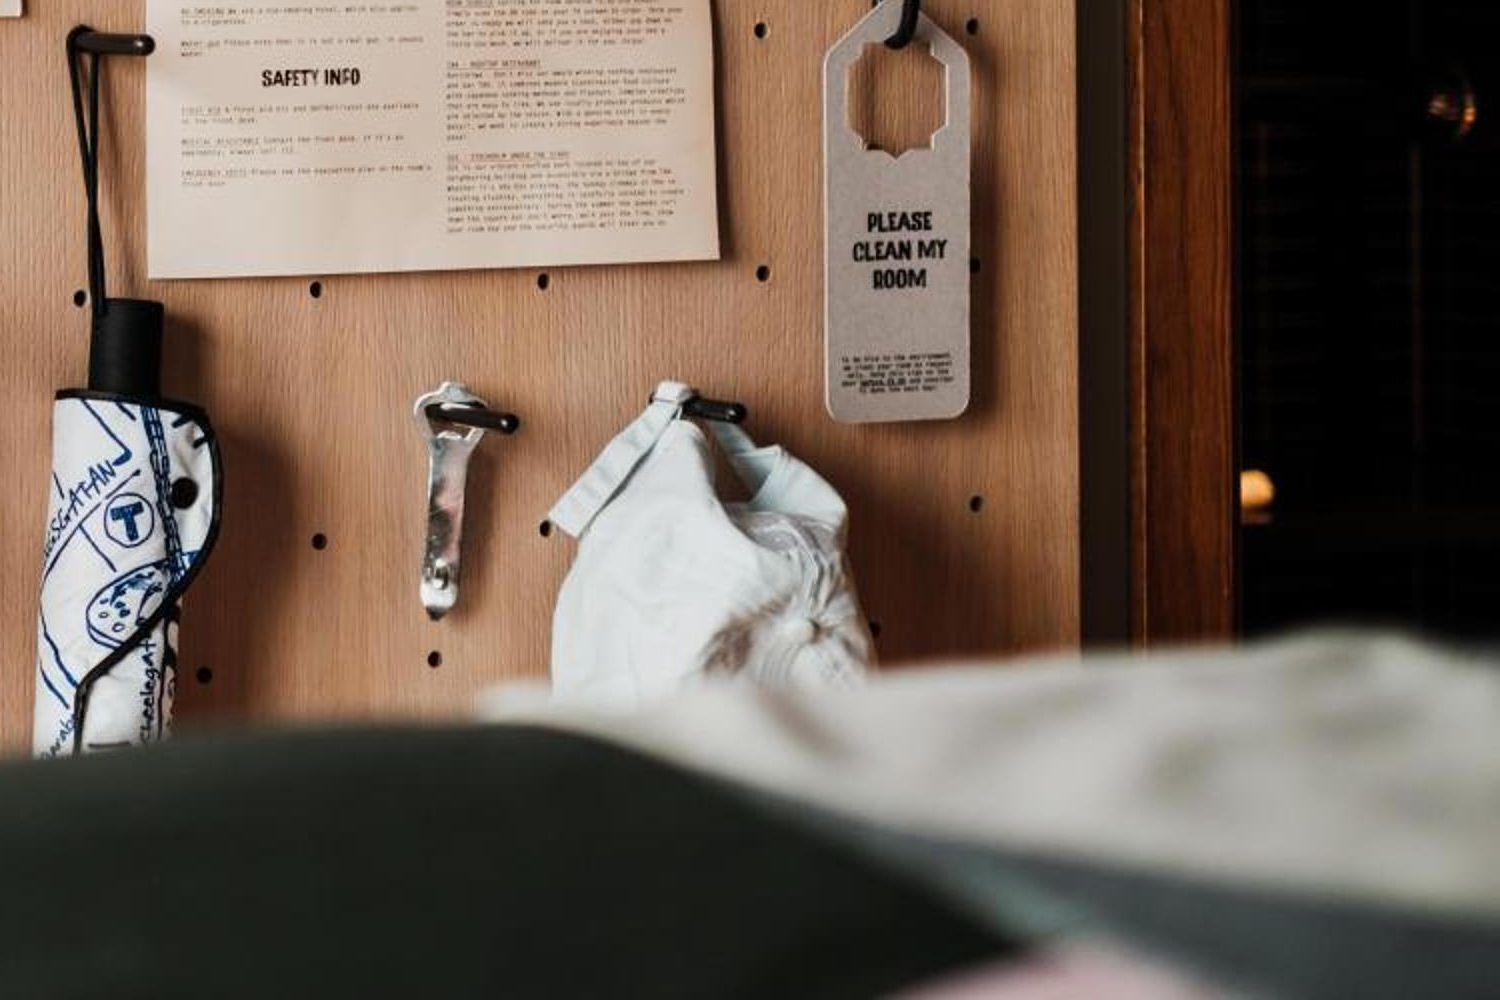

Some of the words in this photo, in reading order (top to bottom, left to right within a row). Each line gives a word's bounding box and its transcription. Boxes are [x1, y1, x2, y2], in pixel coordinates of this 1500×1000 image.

[261, 69, 318, 87] SAFETY
[324, 68, 361, 86] INFO
[868, 212, 932, 232] PLEASE
[853, 241, 912, 262] CLEAN
[918, 240, 947, 259] MY
[873, 269, 927, 289] ROOM
[110, 501, 144, 542] T
